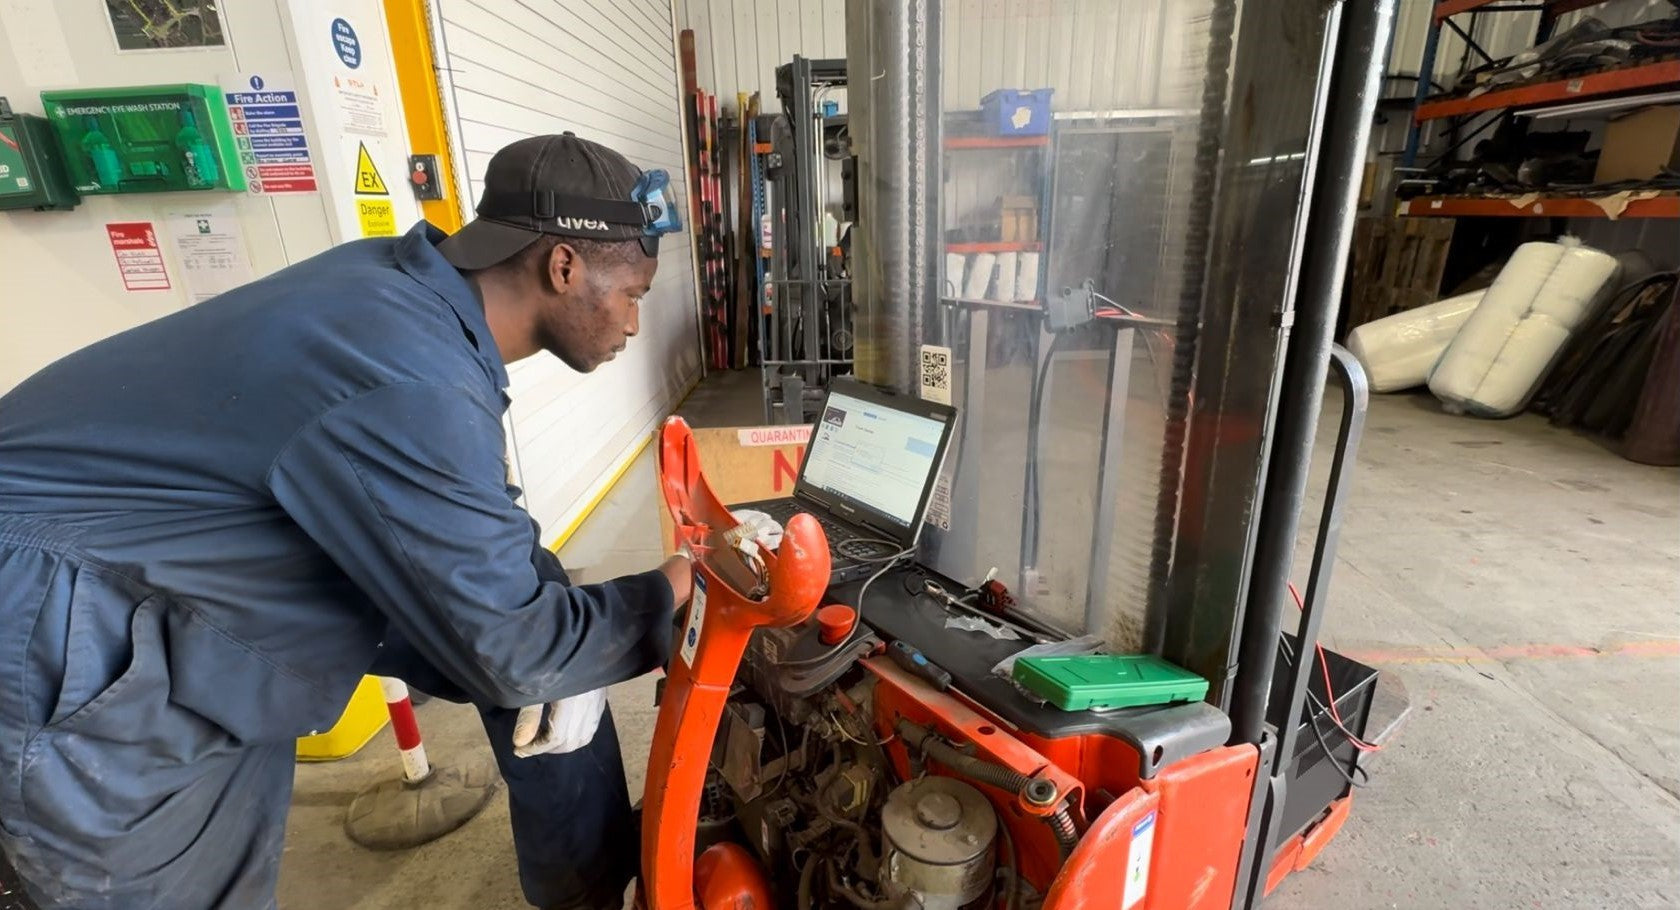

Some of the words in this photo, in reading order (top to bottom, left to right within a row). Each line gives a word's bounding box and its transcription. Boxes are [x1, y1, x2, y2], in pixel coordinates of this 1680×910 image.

[337, 22, 350, 34] Fire
[234, 94, 253, 103] Fire
[255, 93, 288, 103] Action
[66, 105, 110, 116] EMERGENCY
[111, 104, 125, 114] EYE
[125, 103, 148, 113] WASH
[149, 102, 181, 112] STATION
[362, 171, 379, 188] EX
[361, 203, 389, 218] Danger
[557, 216, 609, 231] uvex
[750, 428, 811, 444] QUARANTIN
[773, 446, 804, 492] N
